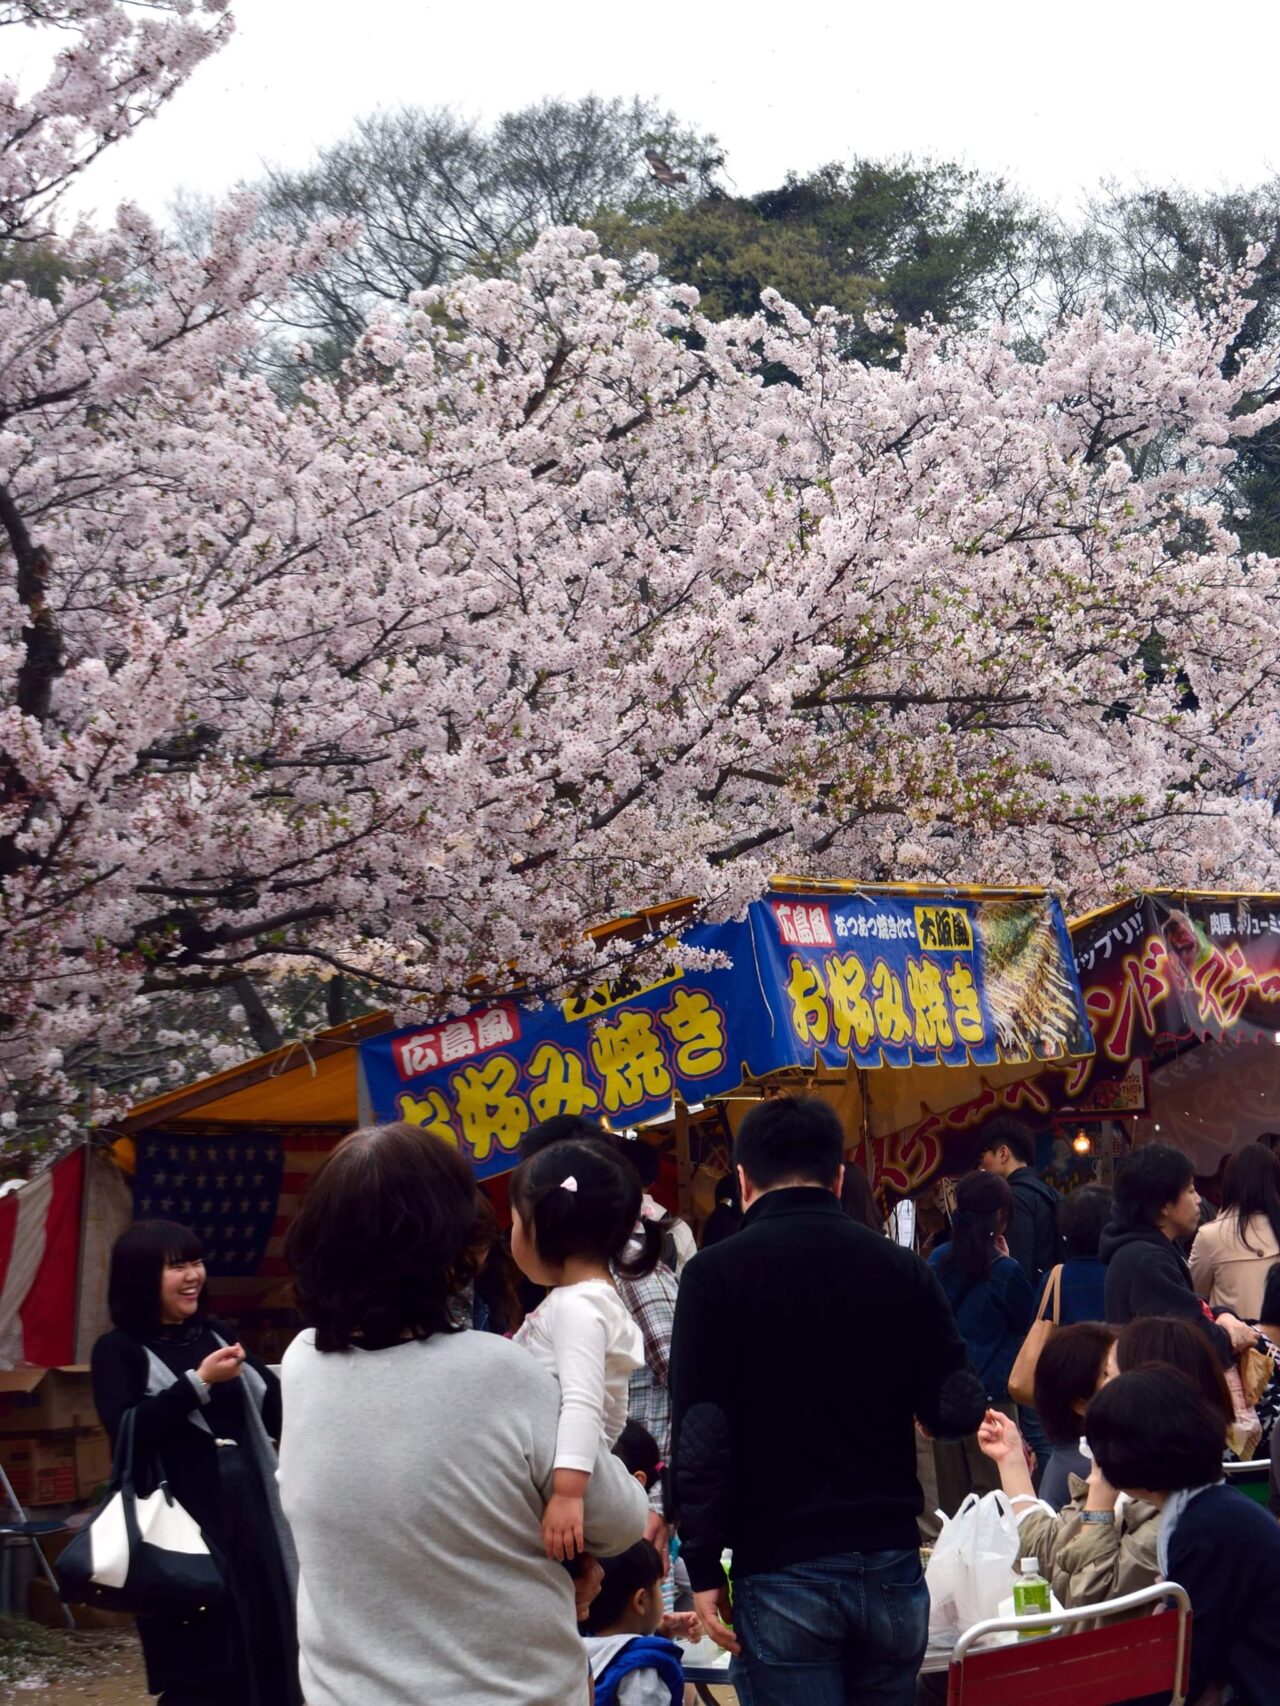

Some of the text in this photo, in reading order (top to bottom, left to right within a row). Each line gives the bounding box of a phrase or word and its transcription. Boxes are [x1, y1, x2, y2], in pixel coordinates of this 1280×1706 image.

[776, 904, 832, 944] 広島風
[919, 910, 970, 948] 大阪風
[786, 955, 985, 1048] お好み焼き
[401, 1008, 514, 1077] 広島風
